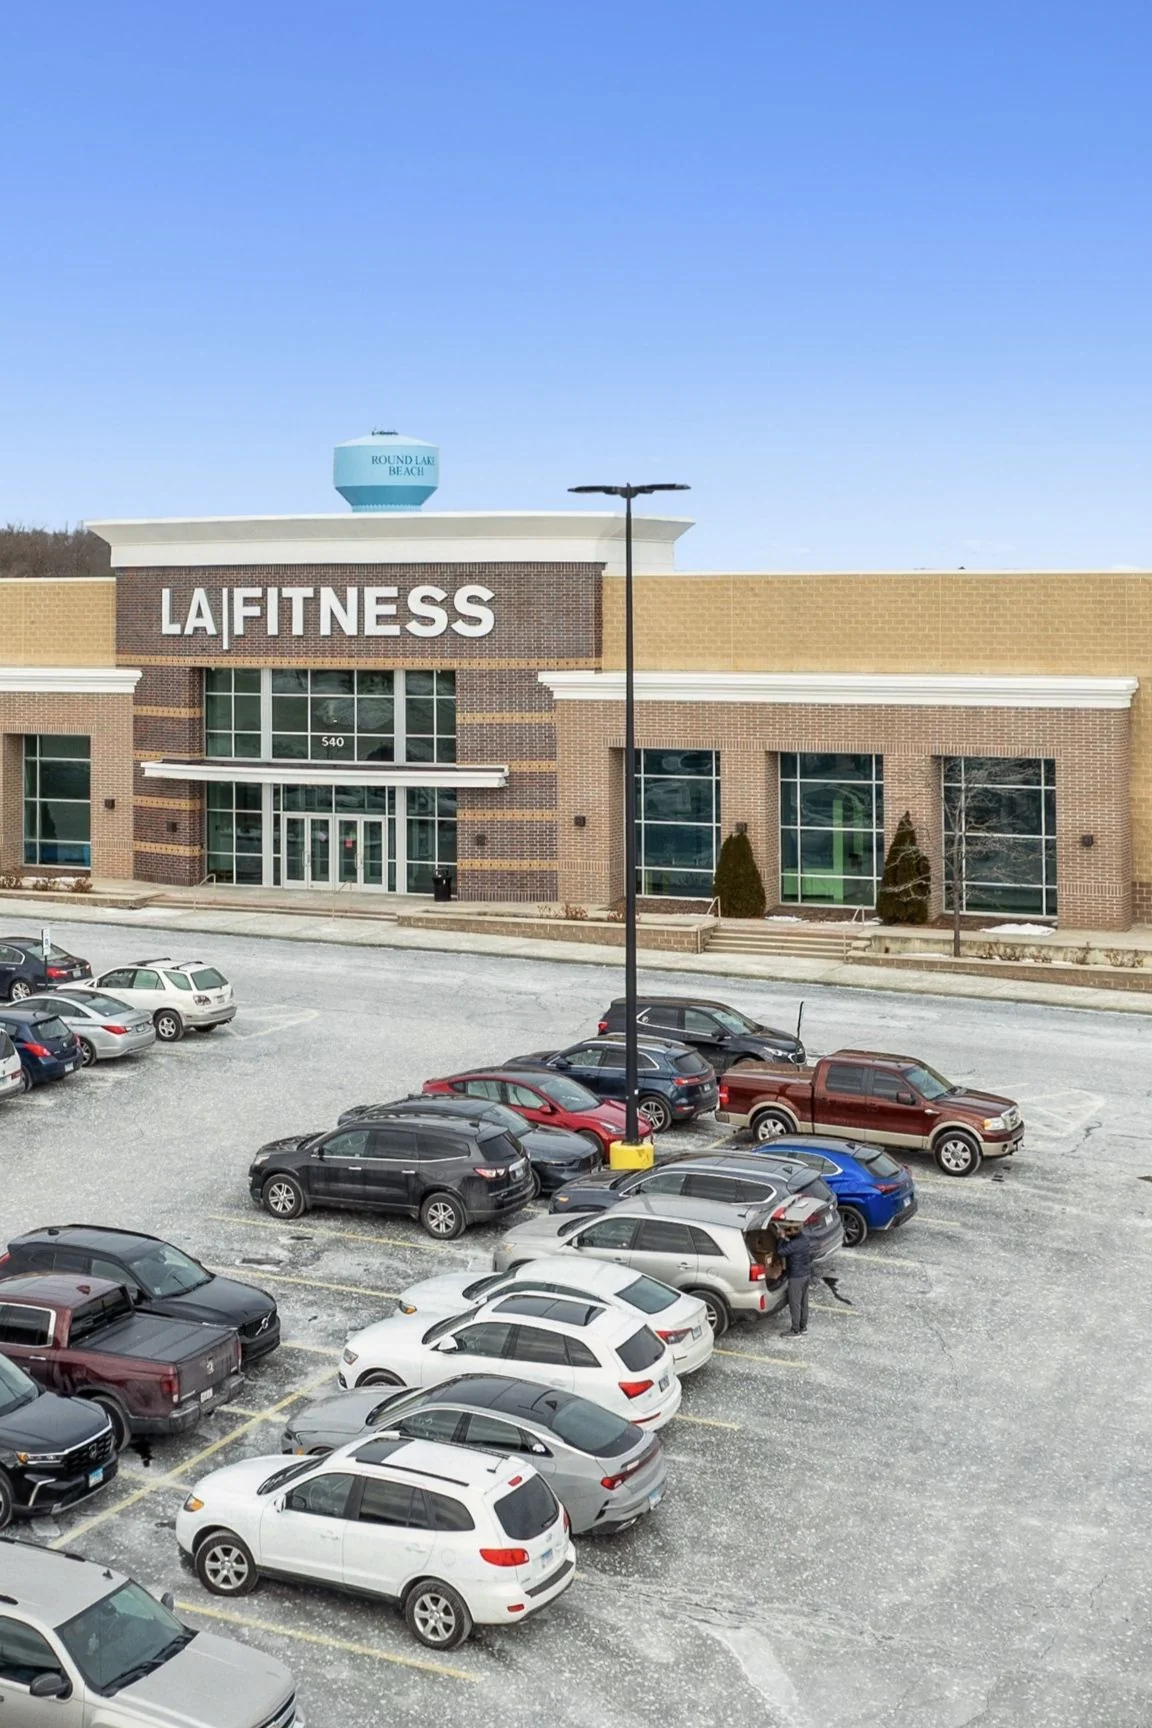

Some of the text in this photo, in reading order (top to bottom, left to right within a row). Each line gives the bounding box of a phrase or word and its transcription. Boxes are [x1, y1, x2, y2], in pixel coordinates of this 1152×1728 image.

[371, 455, 436, 466] ROUND LAKE
[389, 466, 423, 476] BEACH
[321, 736, 344, 748] 540
